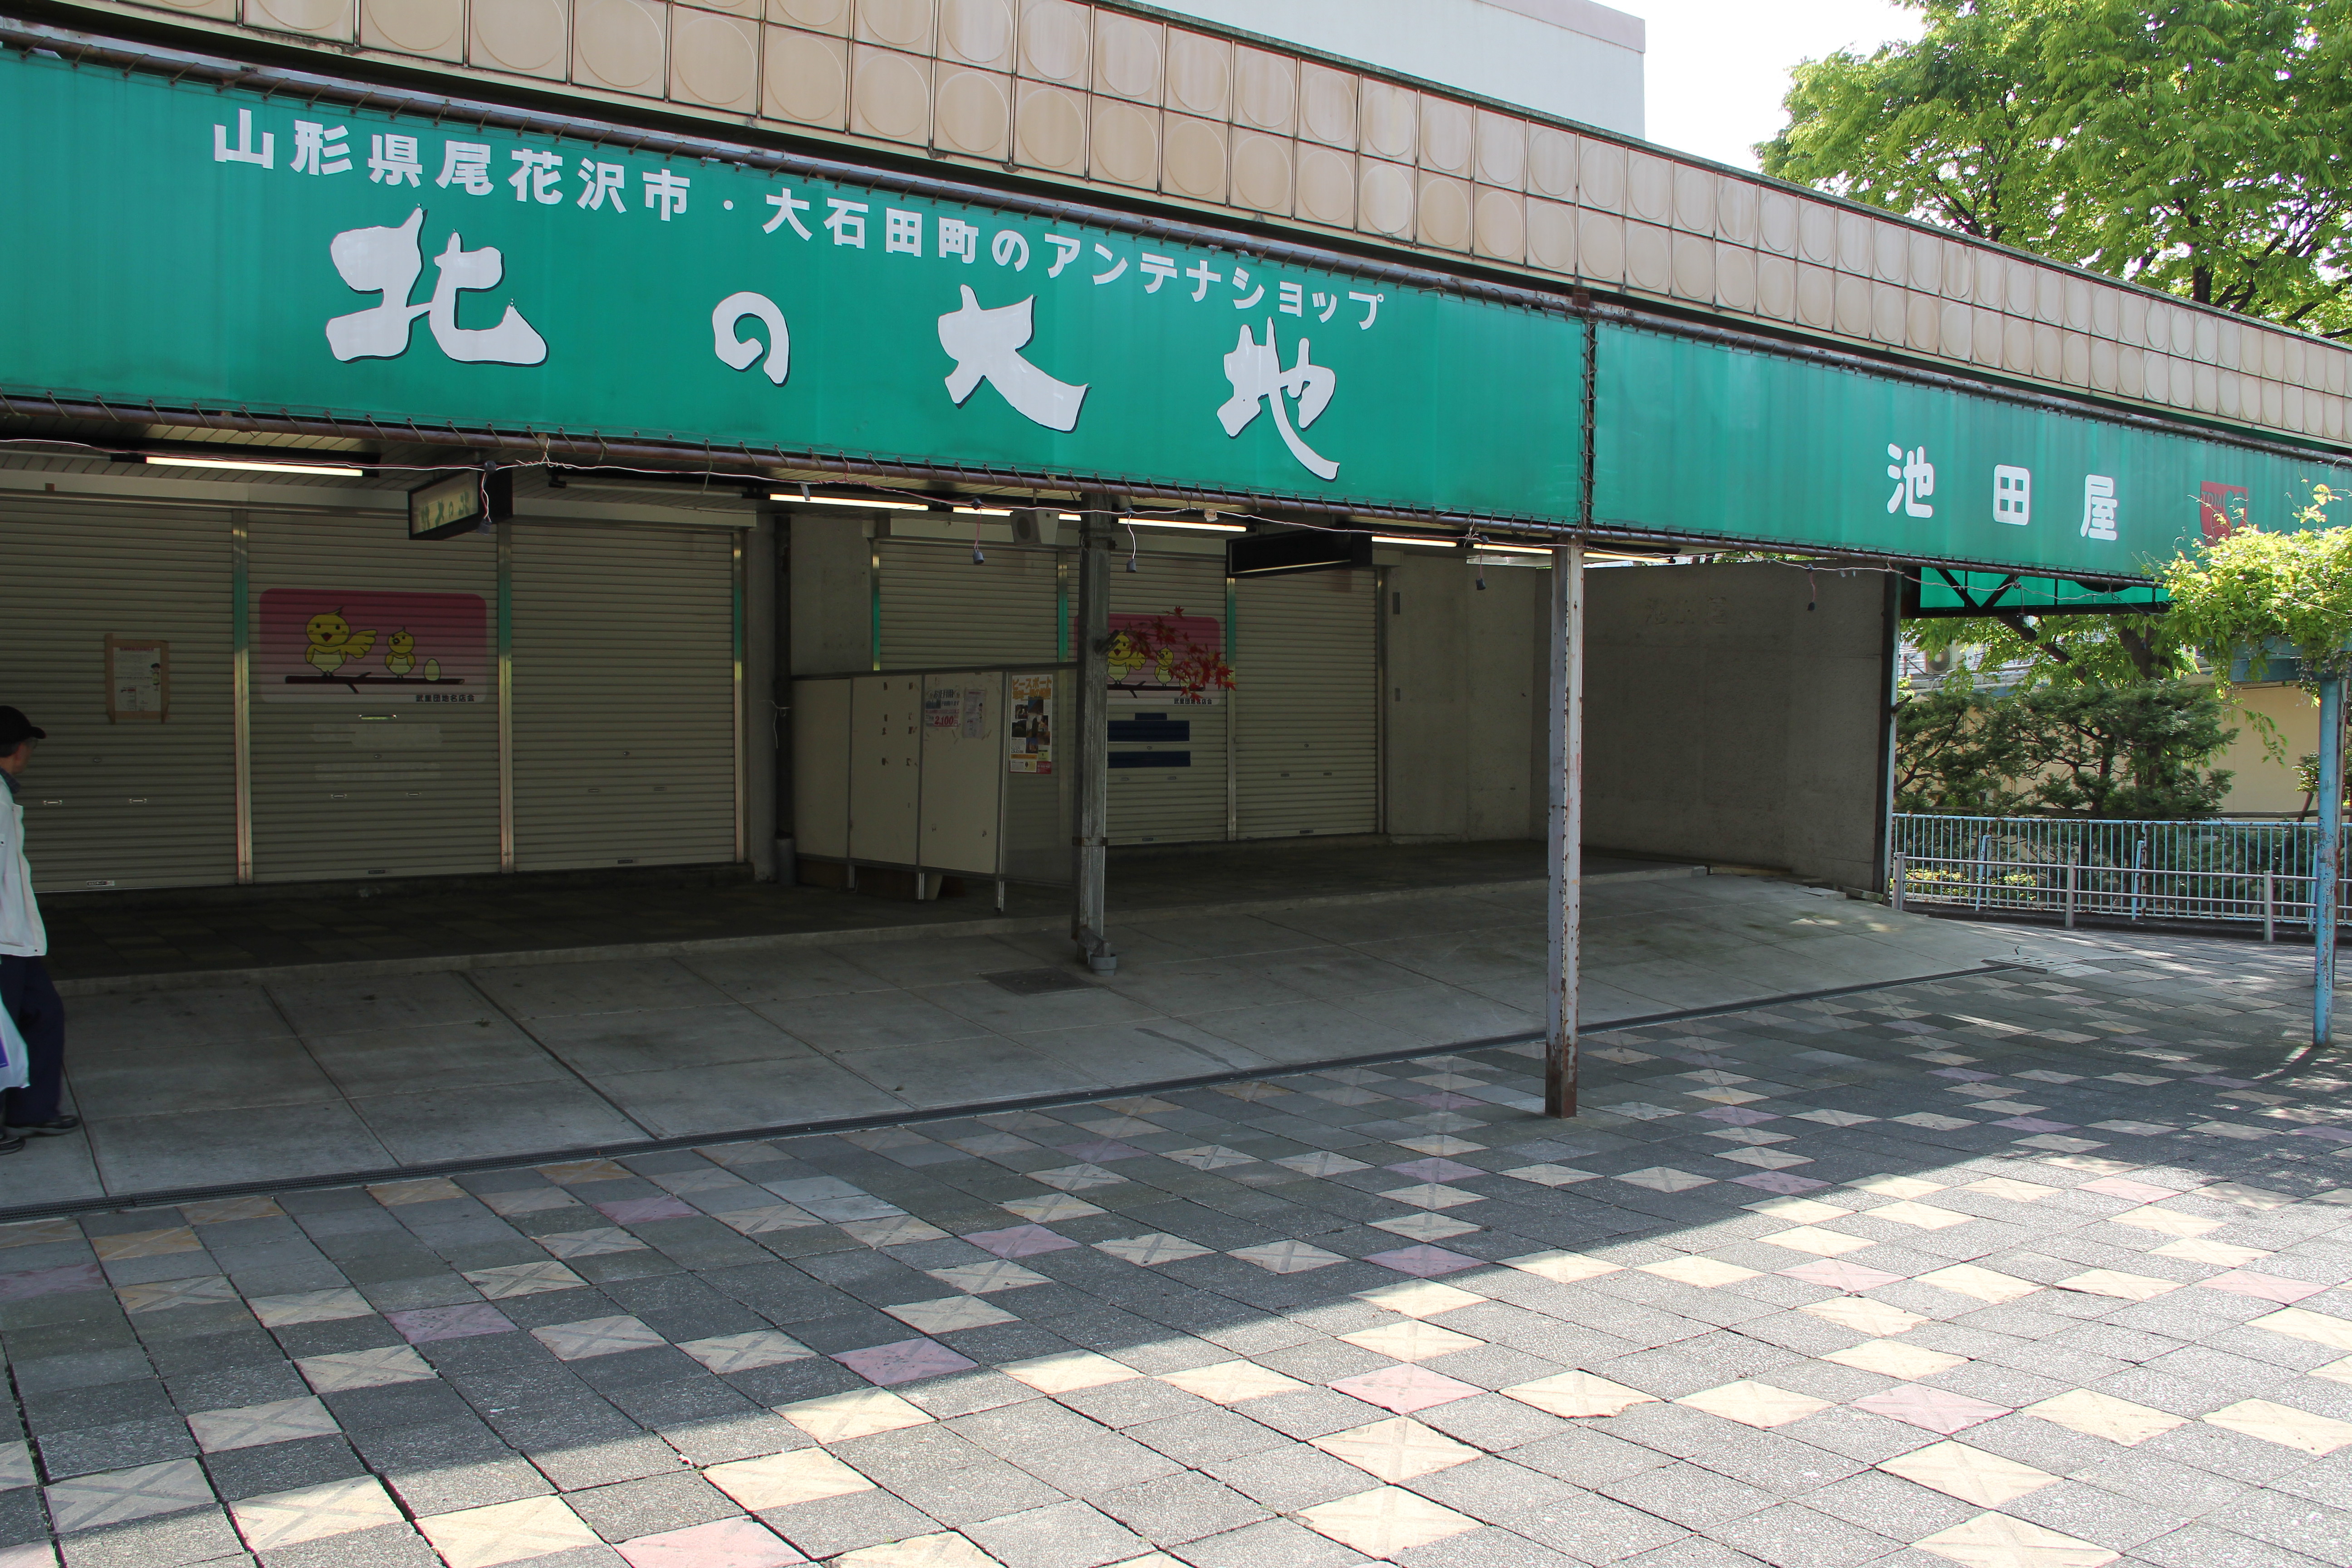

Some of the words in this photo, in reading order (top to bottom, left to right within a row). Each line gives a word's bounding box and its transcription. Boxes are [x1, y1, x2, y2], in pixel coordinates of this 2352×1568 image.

[214, 108, 1385, 330] 山形県尾花沢市・大石田町のアンテナショップ
[326, 204, 1341, 482] 北の大地
[1886, 443, 2118, 541] 池田屋
